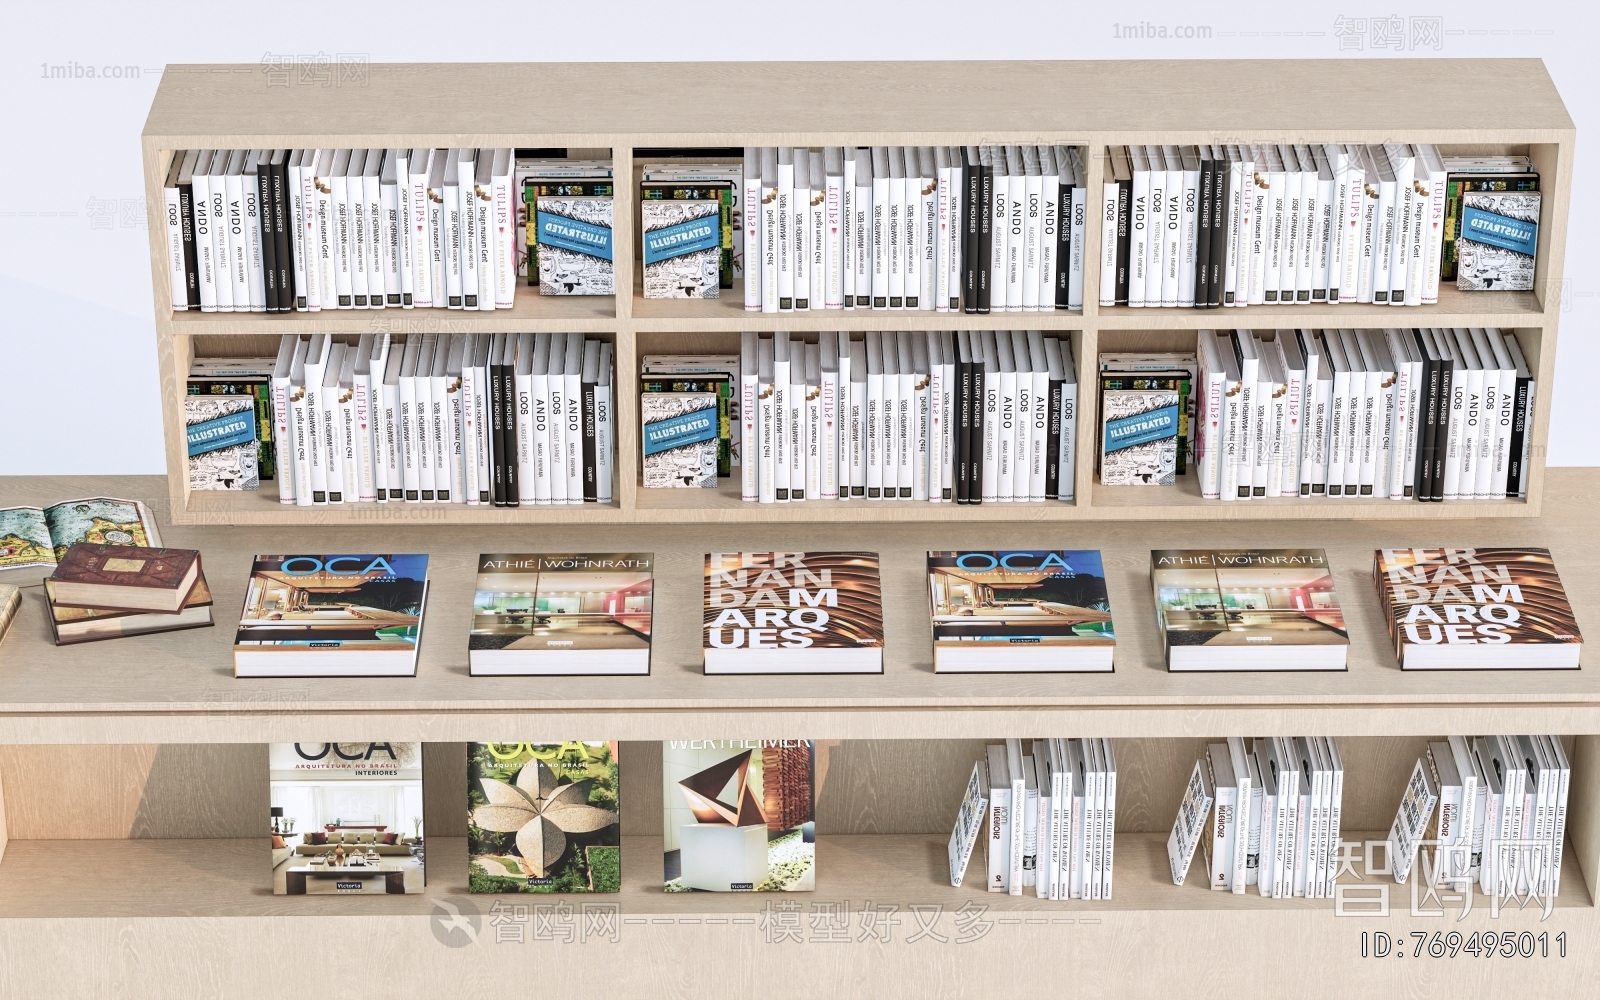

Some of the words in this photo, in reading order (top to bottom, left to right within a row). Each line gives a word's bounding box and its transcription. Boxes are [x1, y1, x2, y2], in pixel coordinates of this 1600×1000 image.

[497, 185, 506, 224] TULIPS
[996, 193, 1004, 218] LOOS
[1030, 193, 1038, 218] LOOS
[1351, 179, 1362, 217] TULIPS
[1433, 180, 1444, 218] TULIPS
[1012, 201, 1021, 235] ANDO
[1045, 201, 1054, 235] ANDO
[1075, 204, 1083, 226] LOOS
[650, 226, 711, 249] ILLUSTRATED
[520, 392, 528, 414] LOOS
[553, 392, 561, 414] LOOS
[1454, 387, 1463, 409] LOOS
[1486, 387, 1495, 409] LOOS
[536, 399, 546, 431] ANDO
[569, 399, 578, 431] ANDO
[1003, 396, 1012, 428] ANDO
[1036, 396, 1044, 428] ANDO
[1468, 394, 1479, 426] ANDO
[1500, 394, 1511, 426] ANDO
[188, 421, 246, 442] ILLUSTRATED
[650, 419, 709, 440] ILLUSTRATED
[1110, 416, 1171, 438] ILLUSTRATED
[281, 556, 396, 576] OCA
[483, 560, 534, 569] ATHIÉ
[545, 559, 649, 568] WOHNRATH
[710, 552, 807, 568] FER
[956, 553, 1074, 572] OCA
[1158, 555, 1209, 565] ATHIÉ
[1218, 556, 1323, 564] WOHNRATH
[1381, 548, 1482, 564] FER
[710, 569, 832, 587] NAN
[1386, 565, 1513, 583] NAN
[710, 589, 838, 607] DAM
[1392, 585, 1524, 603] DAM
[710, 608, 829, 632] ARQ
[1404, 604, 1522, 628] ARQ
[709, 628, 814, 649] UES
[1404, 624, 1512, 645] UES
